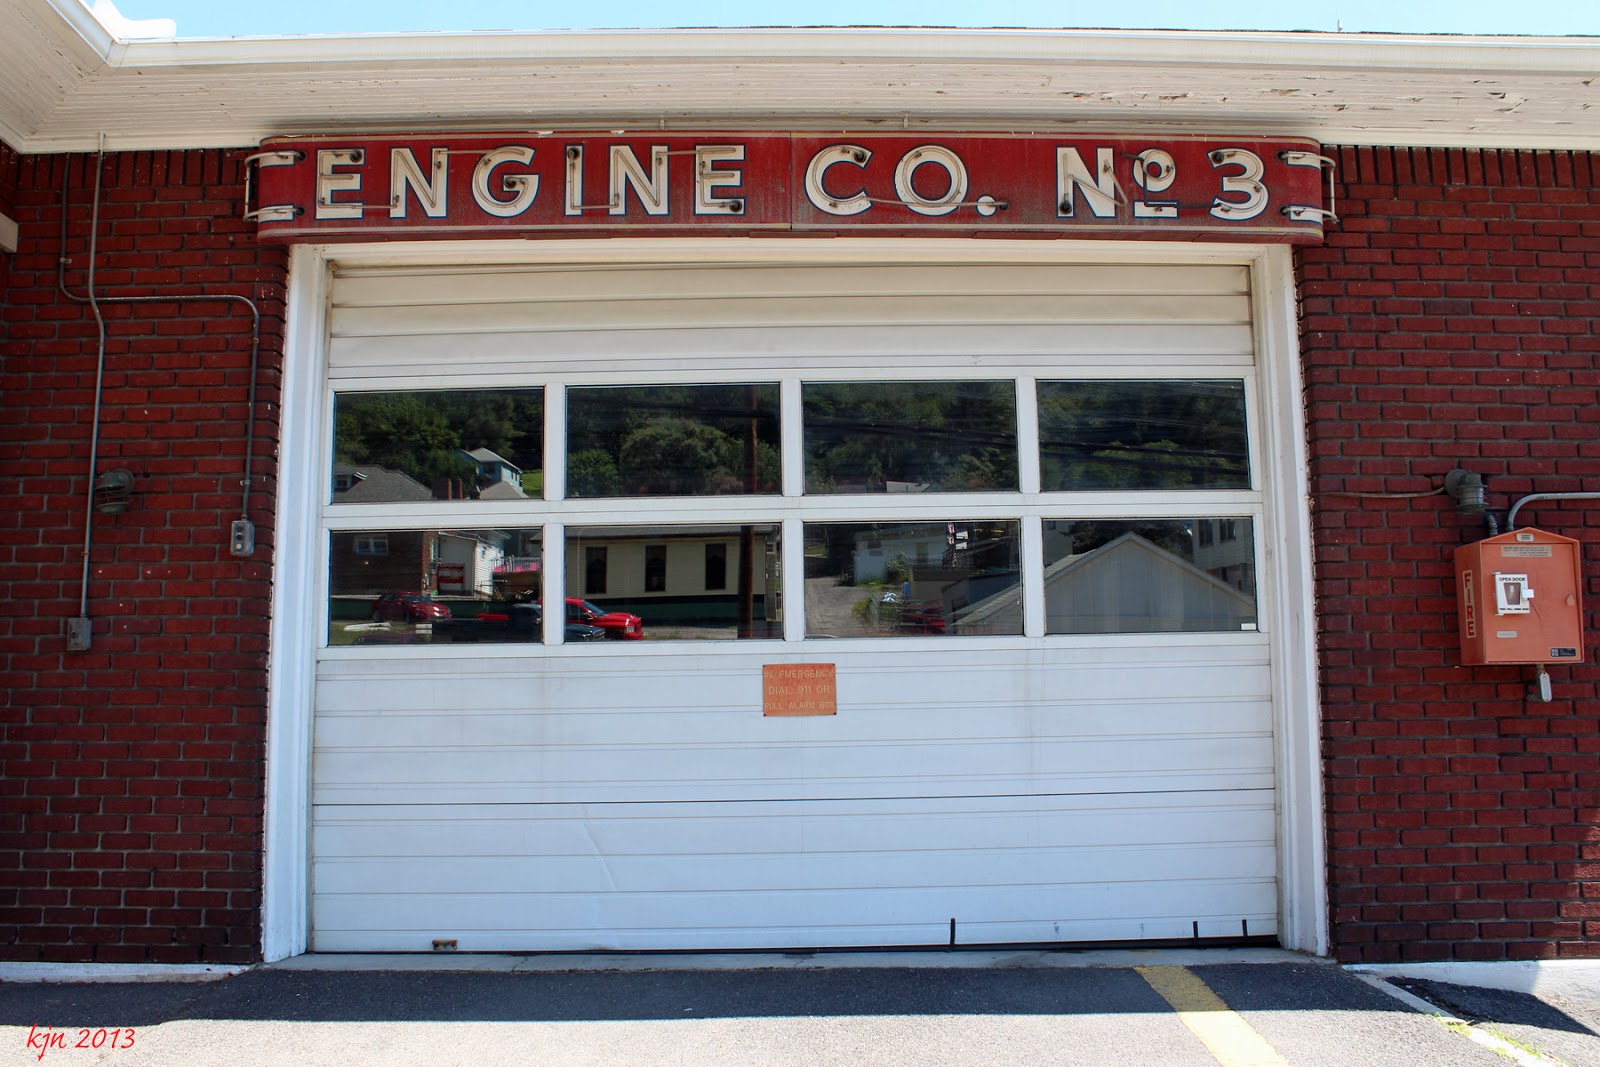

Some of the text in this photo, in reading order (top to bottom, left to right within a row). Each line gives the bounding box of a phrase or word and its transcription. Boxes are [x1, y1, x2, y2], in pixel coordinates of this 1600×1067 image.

[314, 144, 746, 220] ENGINE
[803, 144, 996, 218] CO.
[1206, 147, 1270, 221] 3
[1464, 572, 1476, 636] FIRE
[778, 669, 834, 679] EMERGENCY
[768, 685, 830, 695] DIAL 911 OR
[764, 700, 835, 710] PULL ALARM BOX
